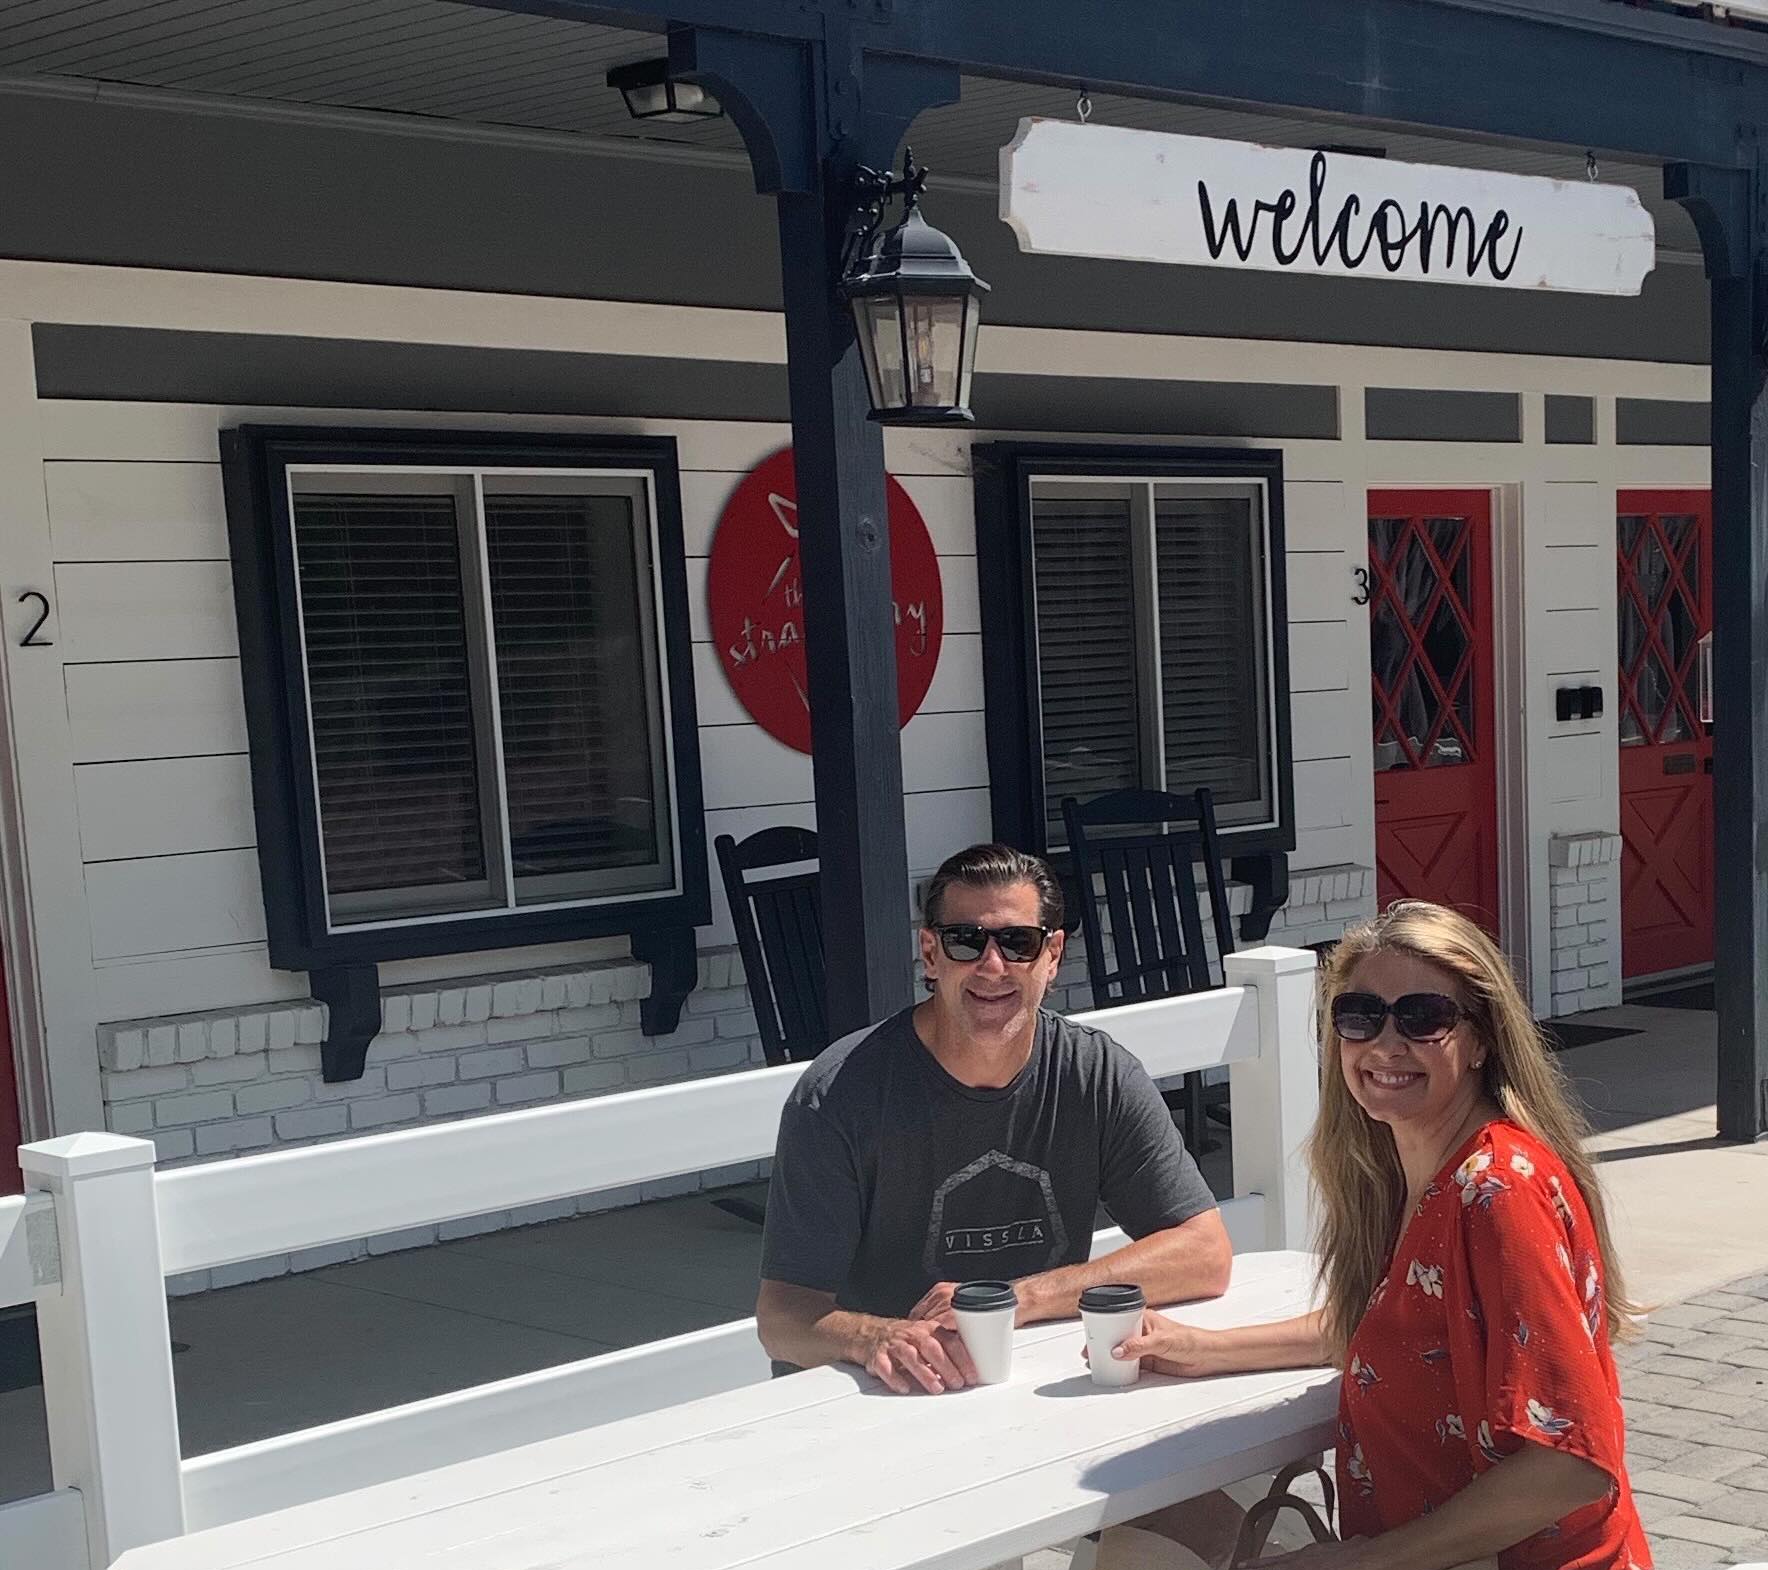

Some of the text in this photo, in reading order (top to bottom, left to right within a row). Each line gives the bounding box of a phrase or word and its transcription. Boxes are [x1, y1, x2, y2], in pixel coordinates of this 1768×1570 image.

[1198, 151, 1523, 280] welcome
[784, 578, 803, 608] th
[1351, 568, 1369, 605] 3
[18, 592, 53, 647] 2
[945, 1225, 1044, 1249] VISSLA
